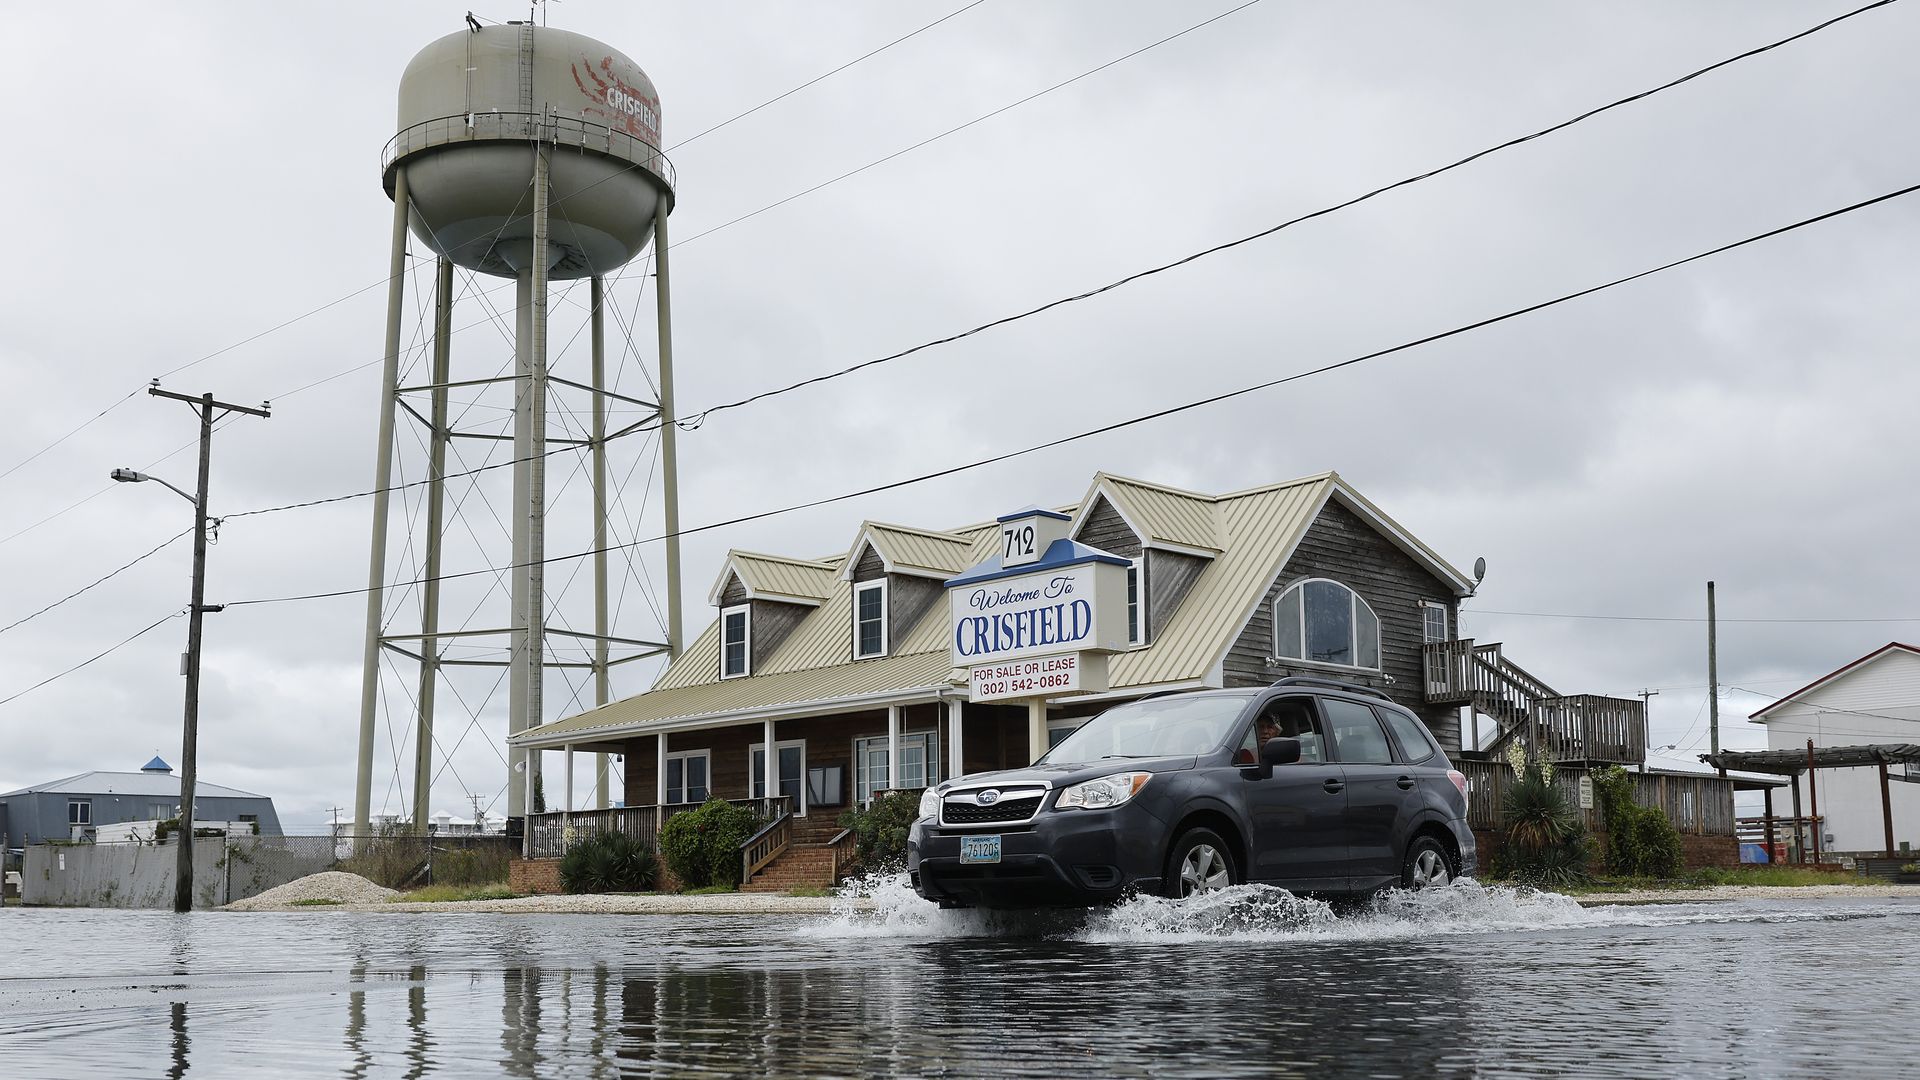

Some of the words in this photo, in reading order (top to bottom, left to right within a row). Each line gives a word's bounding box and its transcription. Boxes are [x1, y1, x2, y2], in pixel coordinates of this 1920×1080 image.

[607, 88, 656, 132] CRISFIELD
[1005, 526, 1033, 558] 712
[970, 588, 1040, 610] Welcome
[1043, 576, 1075, 599] To
[956, 599, 1092, 657] CRISFIELD
[974, 669, 993, 681] FOR
[996, 665, 1021, 678] SALE
[1024, 662, 1039, 675] OR
[1042, 658, 1075, 672] LEASE
[980, 680, 1008, 696] (302)
[1011, 673, 1070, 691] 542-0862
